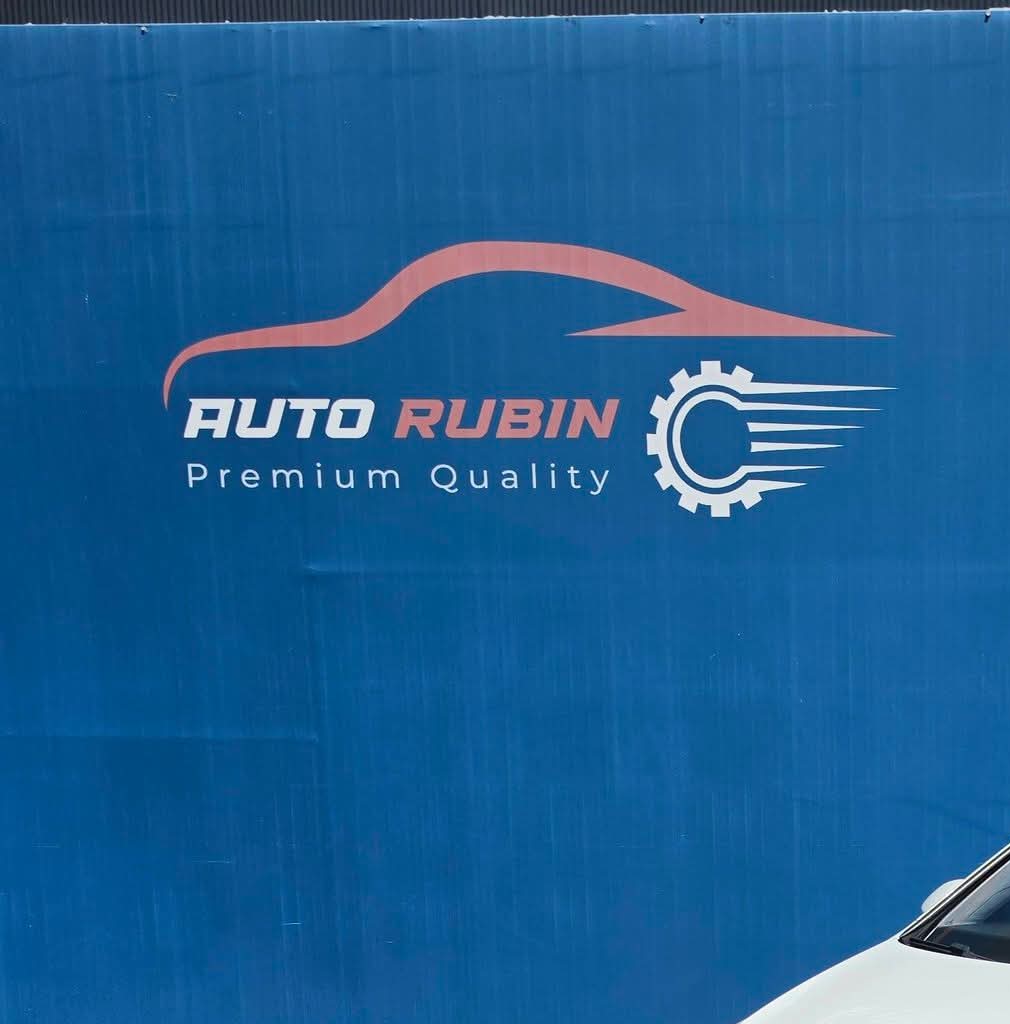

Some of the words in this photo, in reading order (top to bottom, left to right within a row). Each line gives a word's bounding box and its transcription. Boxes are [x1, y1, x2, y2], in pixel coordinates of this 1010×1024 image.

[183, 398, 376, 439] AUTO
[394, 398, 620, 439] RUBIN
[187, 462, 400, 489] Premium
[430, 463, 610, 496] Quality
